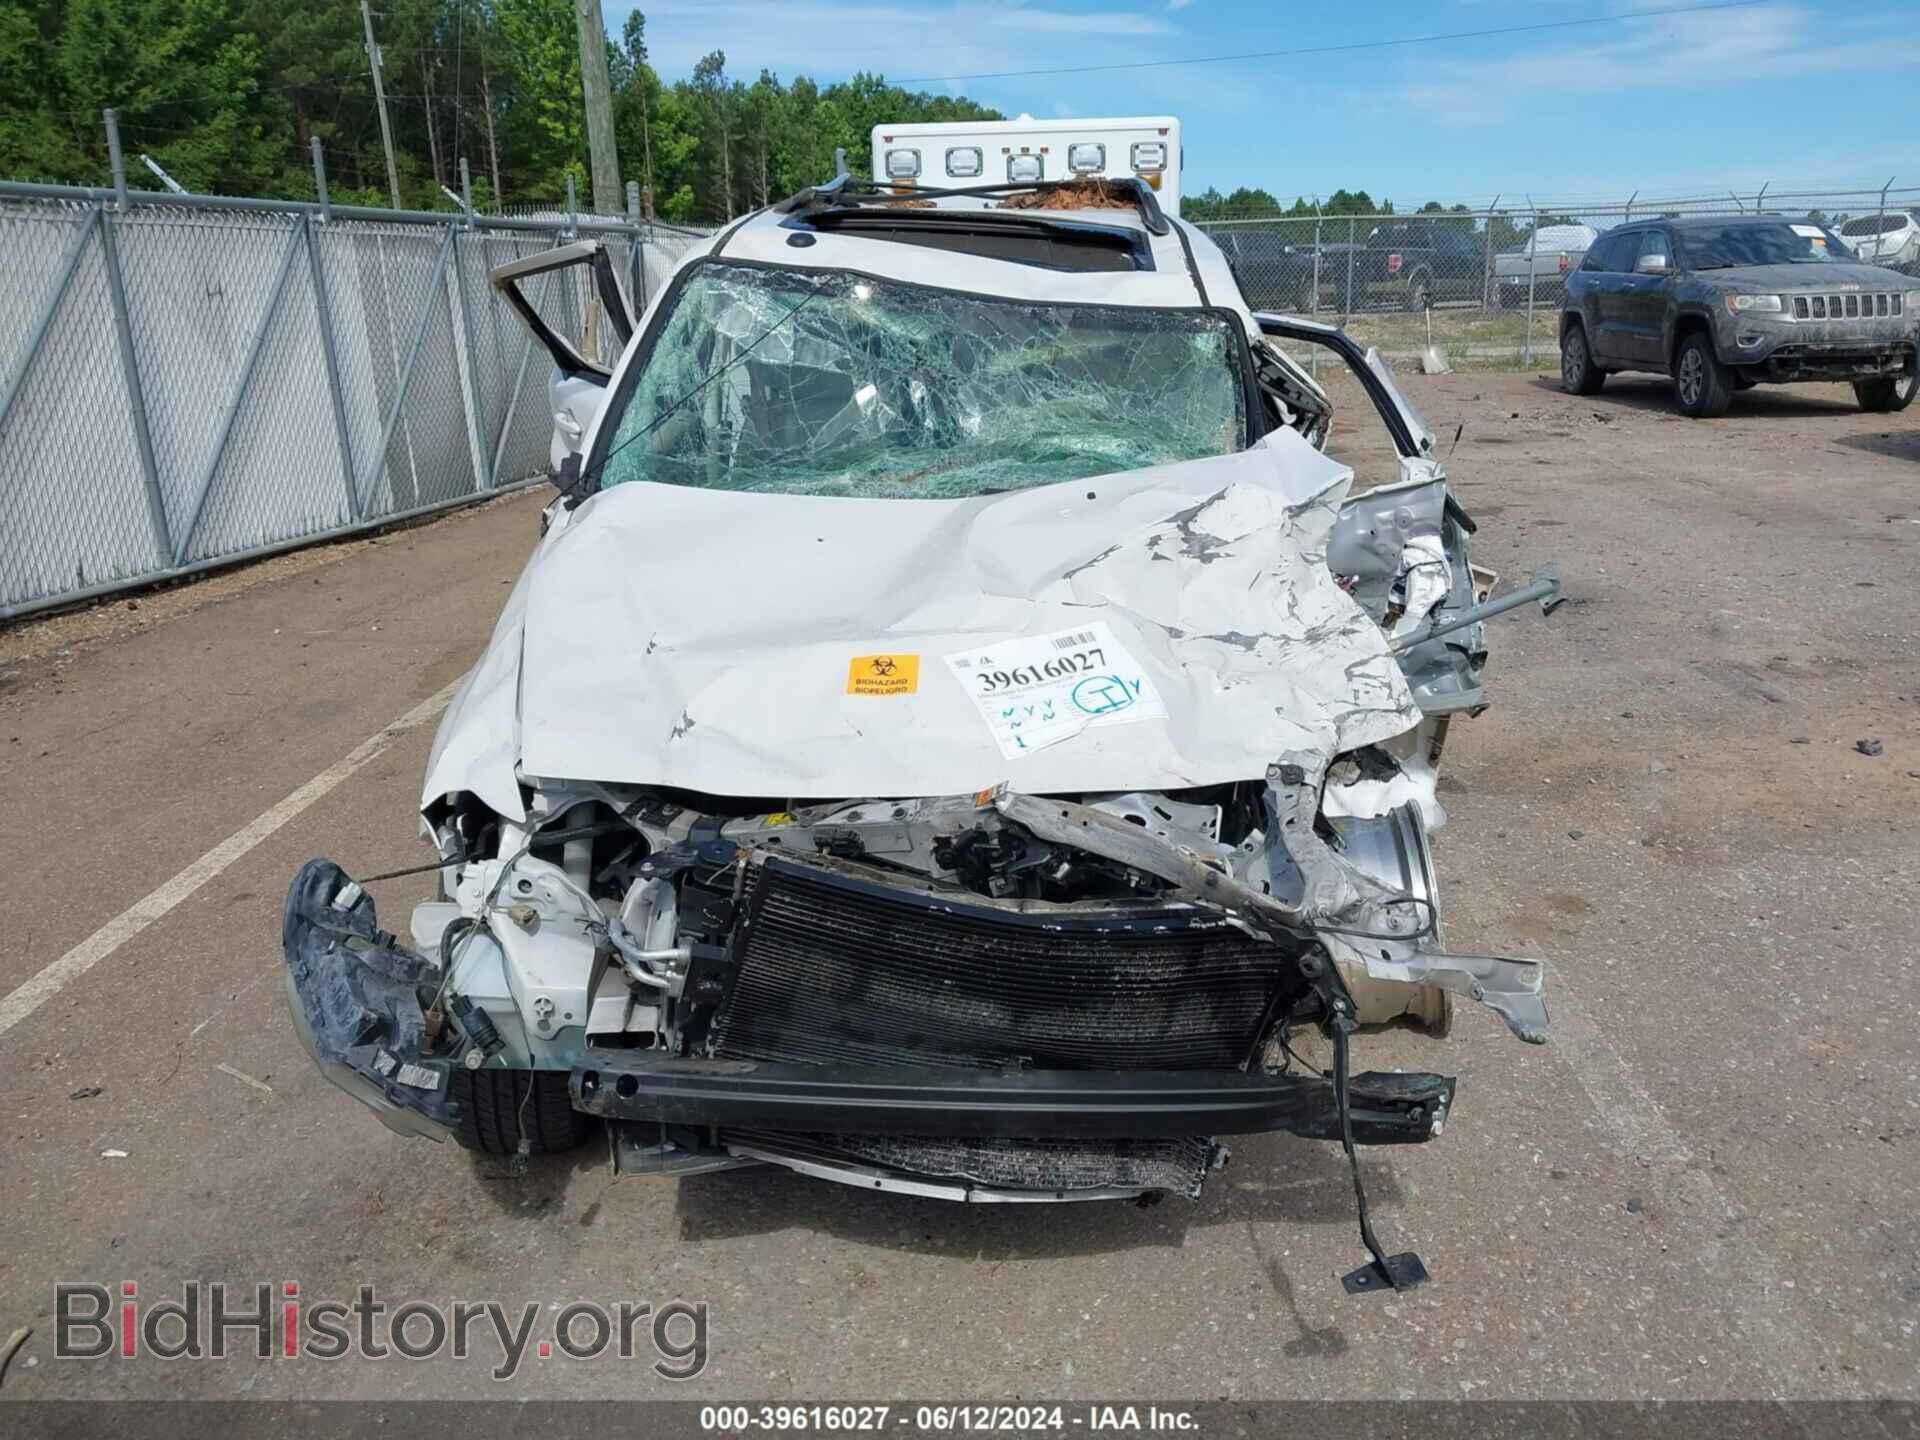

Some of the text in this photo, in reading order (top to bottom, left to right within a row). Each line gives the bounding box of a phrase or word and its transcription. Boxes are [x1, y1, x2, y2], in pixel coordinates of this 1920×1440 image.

[977, 648, 1107, 692] 39616027
[855, 678, 908, 686] BIOHAZARD
[855, 687, 908, 695] BIOPELIGRO
